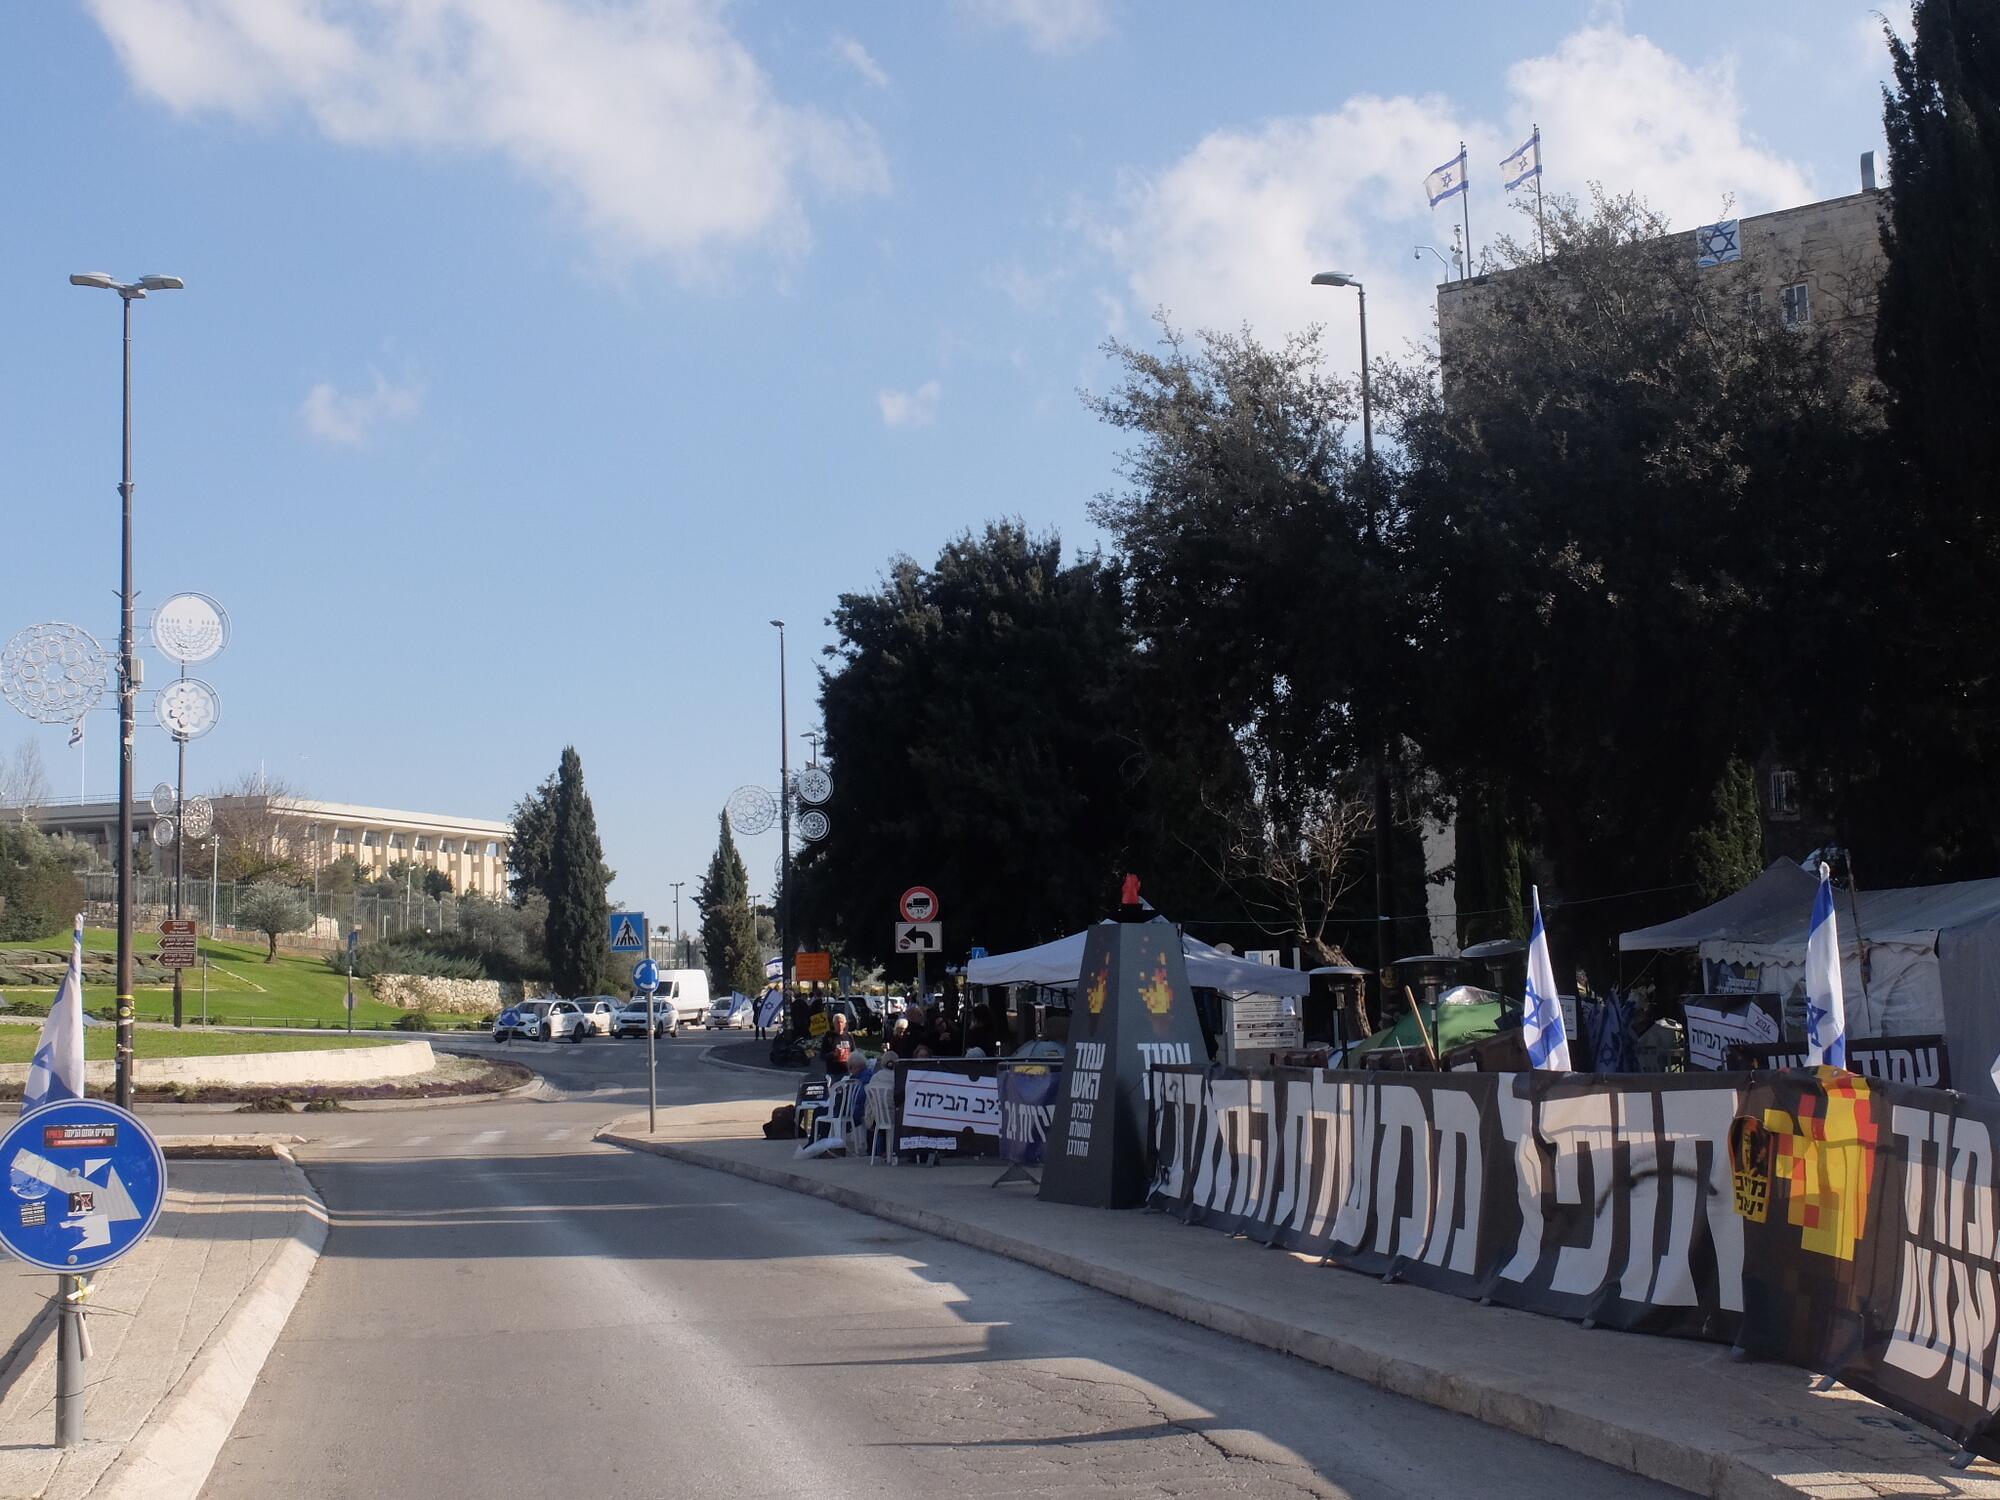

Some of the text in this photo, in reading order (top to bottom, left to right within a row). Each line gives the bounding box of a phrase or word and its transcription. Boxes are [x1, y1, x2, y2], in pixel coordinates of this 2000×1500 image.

[1075, 1041, 1106, 1070] עמוד
[1137, 1042, 1191, 1070] עמוד
[1852, 1048, 1940, 1087] עמוד
[914, 1091, 968, 1113] הביזה
[1070, 1071, 1101, 1100] האש
[1070, 1102, 1094, 1119] להפלת
[1273, 1068, 1483, 1275] ממשלת
[1892, 1105, 2000, 1262] מוד
[1497, 1072, 1744, 1312] תופל
[1883, 1239, 2000, 1412] אש
